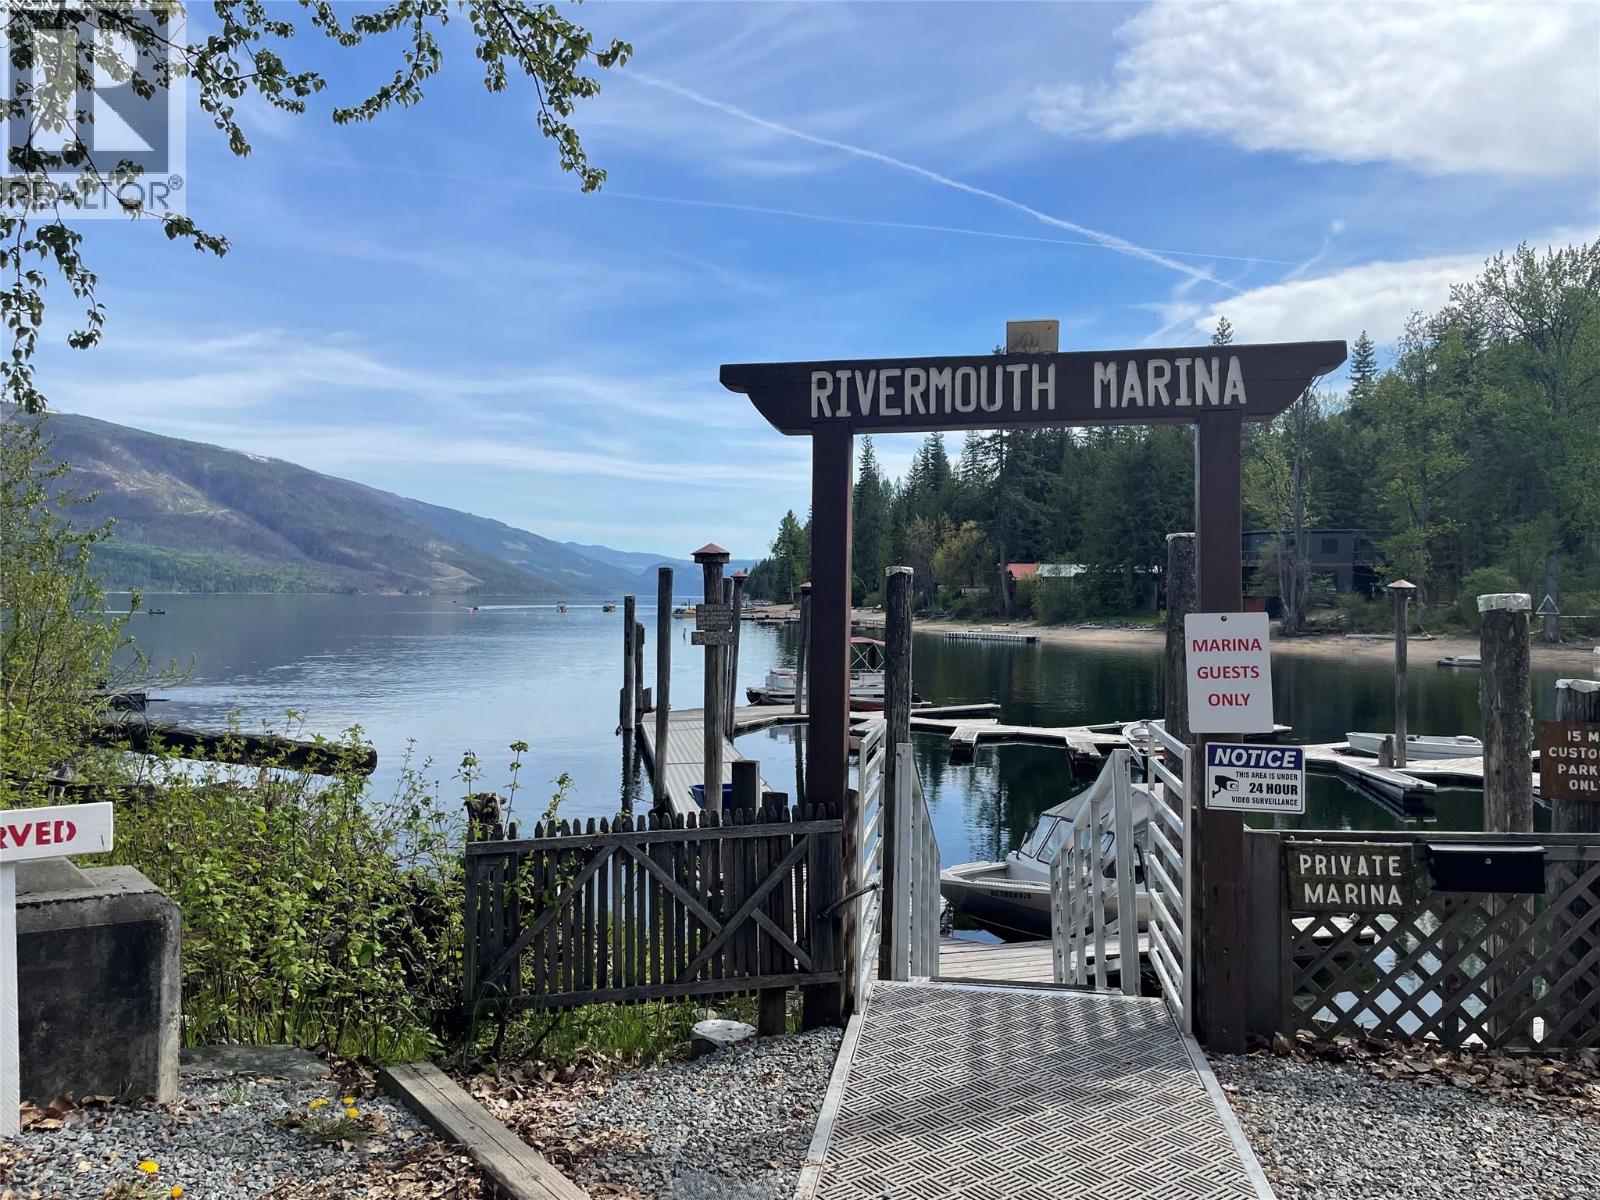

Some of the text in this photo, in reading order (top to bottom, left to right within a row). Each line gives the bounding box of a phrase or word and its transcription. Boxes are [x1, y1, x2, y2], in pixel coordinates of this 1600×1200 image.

[810, 355, 1248, 419] RIVERMOUTH MARINA
[1192, 638, 1263, 653] MARINA
[1196, 665, 1260, 680] GUESTS
[1207, 693, 1251, 707] ONLY
[1567, 730, 1582, 742] 15
[1213, 747, 1297, 768] NOTICE
[1548, 747, 1600, 760] CUSTO
[1235, 771, 1250, 779] THIS
[1277, 773, 1298, 781] UNDER
[1557, 763, 1598, 776] PARK
[1249, 782, 1298, 795] 24 HOUR
[1568, 779, 1600, 791] ONL
[1231, 796, 1298, 806] VIDEO SURVEILLANCE
[1299, 854, 1403, 877] PRIVATE
[1304, 883, 1403, 906] MARINA
